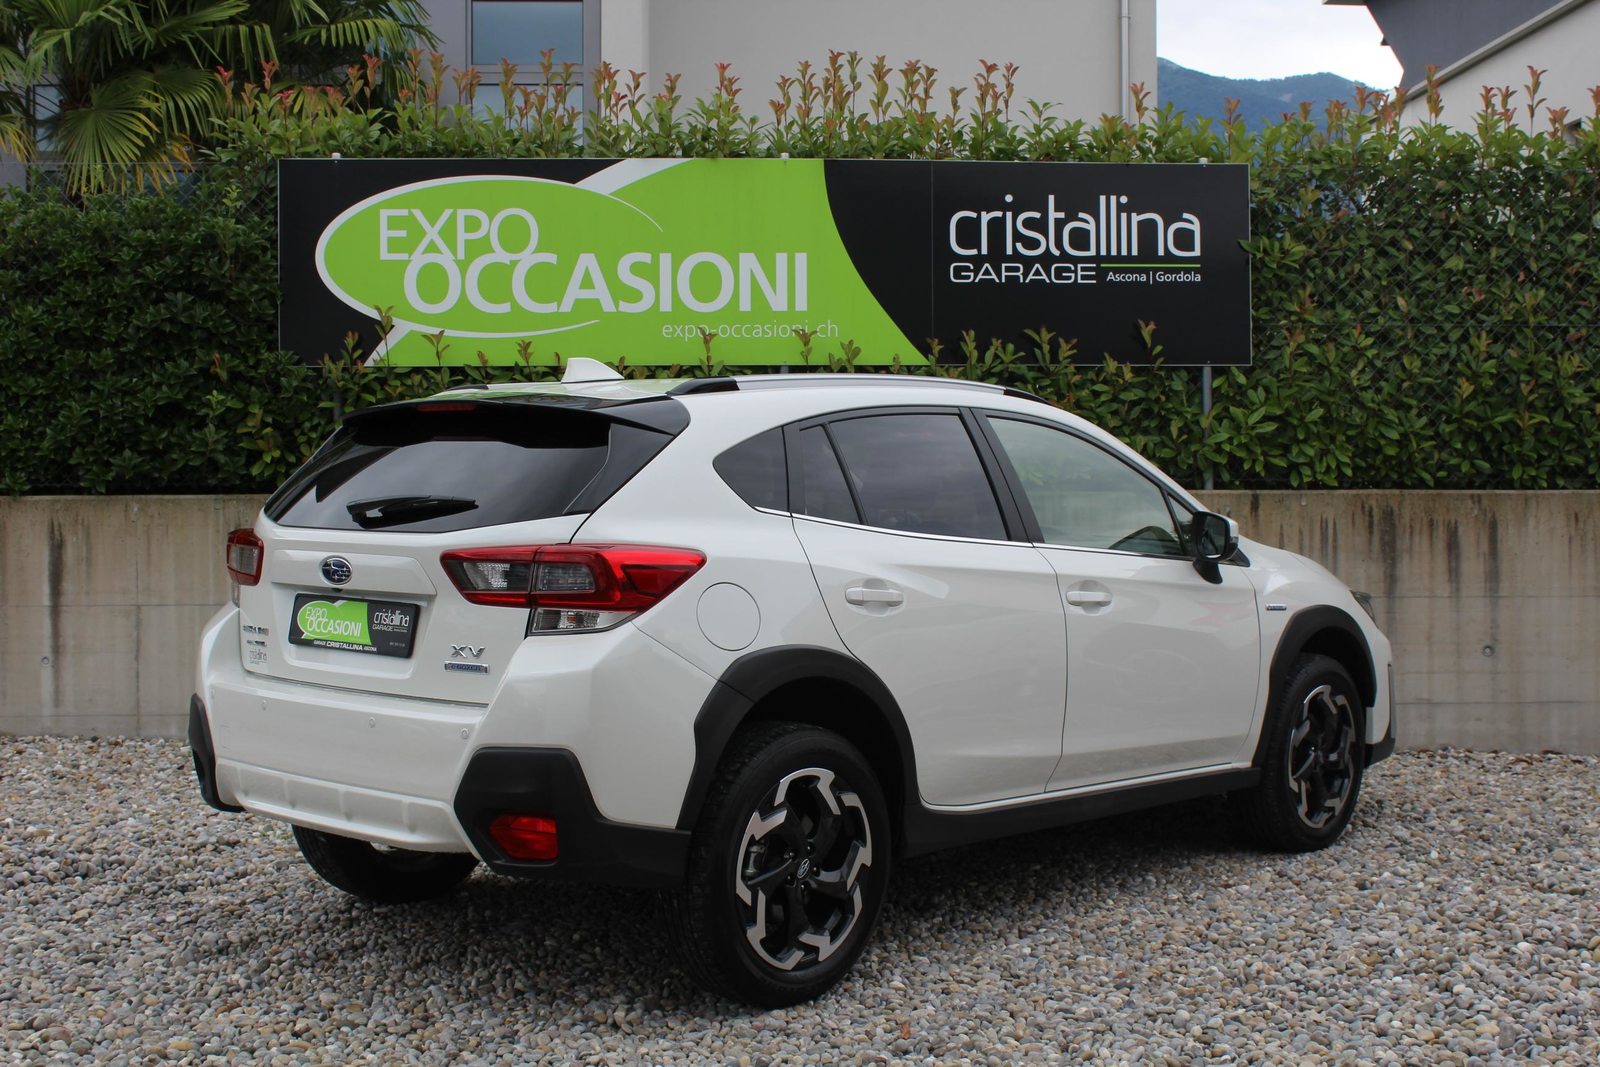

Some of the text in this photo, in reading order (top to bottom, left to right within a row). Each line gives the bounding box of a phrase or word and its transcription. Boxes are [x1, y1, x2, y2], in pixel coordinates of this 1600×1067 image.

[379, 207, 539, 261] EXPO
[949, 194, 1201, 256] cristallina
[403, 252, 808, 312] OCCASIONI
[950, 263, 1097, 283] GARAGE
[1106, 271, 1147, 282] Ascona
[1155, 271, 1201, 282] Gordola
[662, 320, 839, 341] expo-occasionich
[305, 606, 328, 620] EXPO
[307, 618, 362, 637] OCCASIONI
[372, 624, 393, 632] GARAGE
[326, 641, 363, 651] CRISTALLINA
[451, 644, 486, 659] XV
